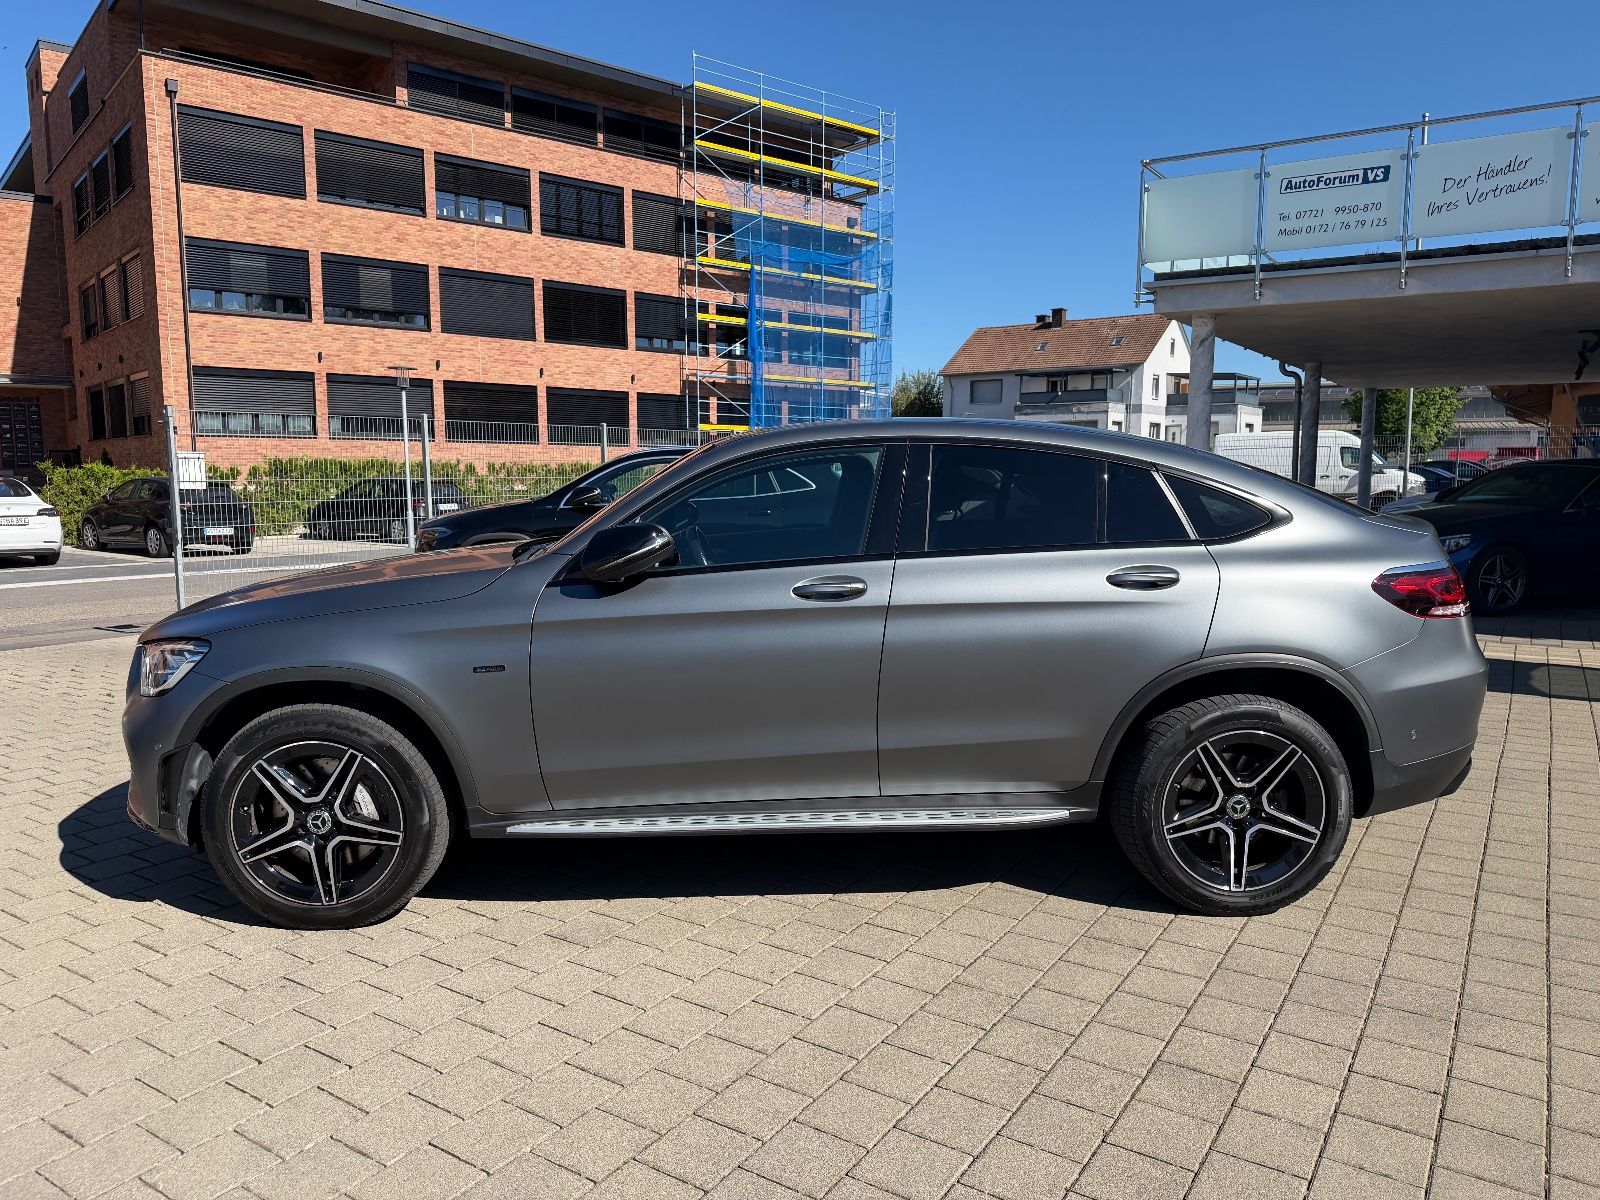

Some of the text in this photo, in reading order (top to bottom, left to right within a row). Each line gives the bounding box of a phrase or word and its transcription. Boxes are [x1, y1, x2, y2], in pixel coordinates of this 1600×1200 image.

[1283, 167, 1385, 192] AutoForum VS
[1442, 154, 1533, 194] Der Händler
[1427, 163, 1552, 218] Ihres Vertrauens!
[1278, 201, 1382, 222] Tel. 07721 9950-870
[1277, 226, 1303, 237] Mobil
[1305, 223, 1329, 235] 0172
[1339, 221, 1351, 231] 76
[1354, 219, 1367, 230] 79
[1370, 217, 1388, 228] 125
